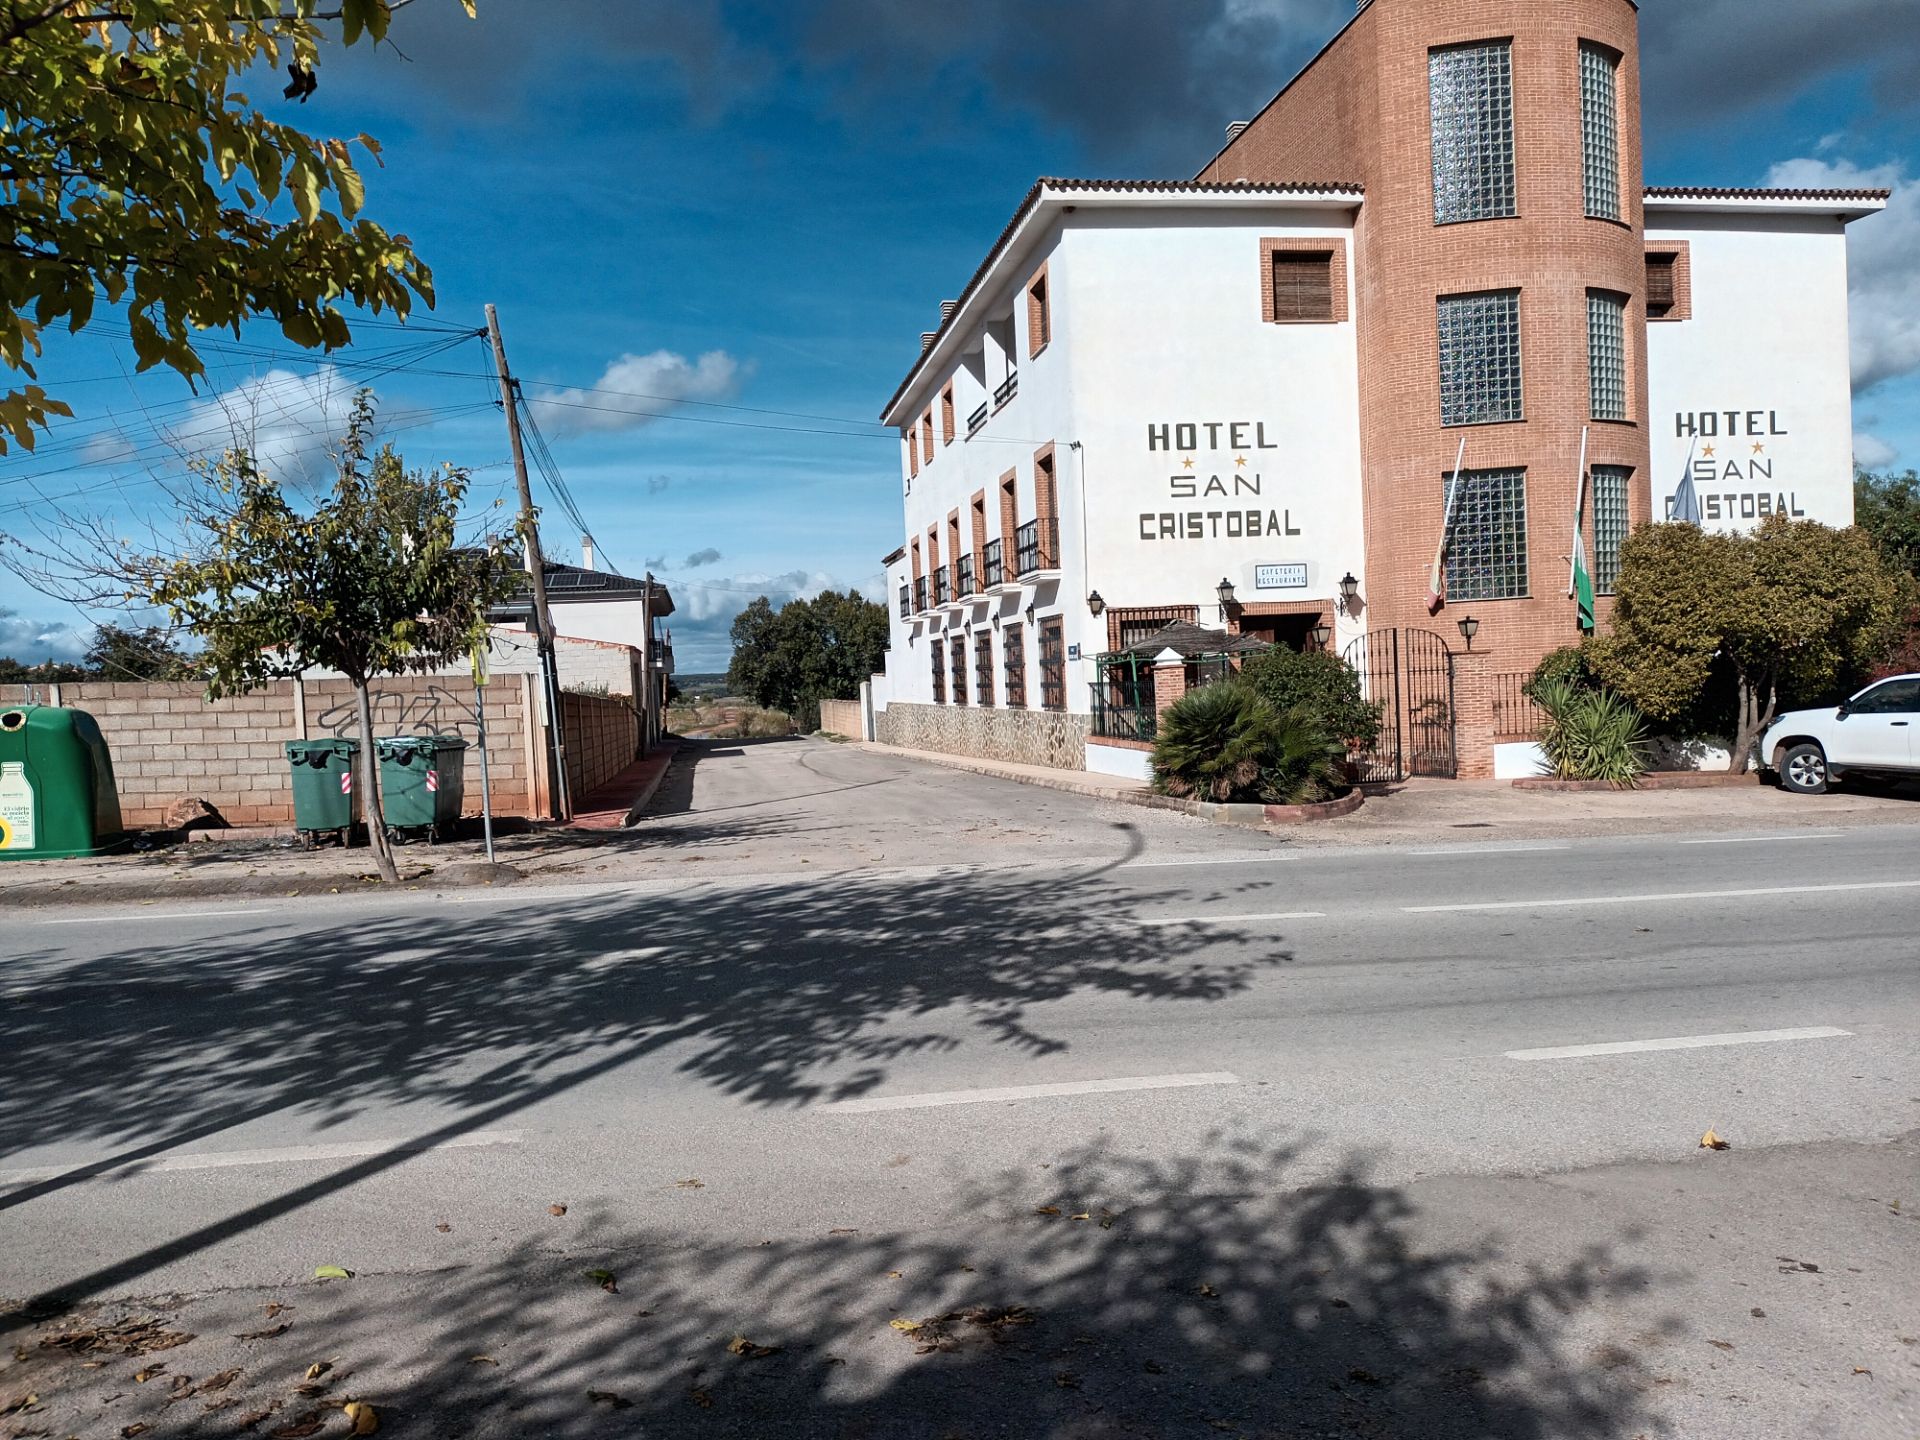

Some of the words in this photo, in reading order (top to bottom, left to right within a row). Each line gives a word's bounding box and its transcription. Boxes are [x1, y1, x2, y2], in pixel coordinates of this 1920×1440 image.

[1148, 422, 1278, 451] HOTEL
[1675, 411, 1788, 438] HOTEL
[1693, 458, 1772, 481] SAN
[1170, 474, 1260, 498] SAN
[1664, 492, 1805, 520] CISTOBAL
[1139, 509, 1301, 540] CRISTOBAL
